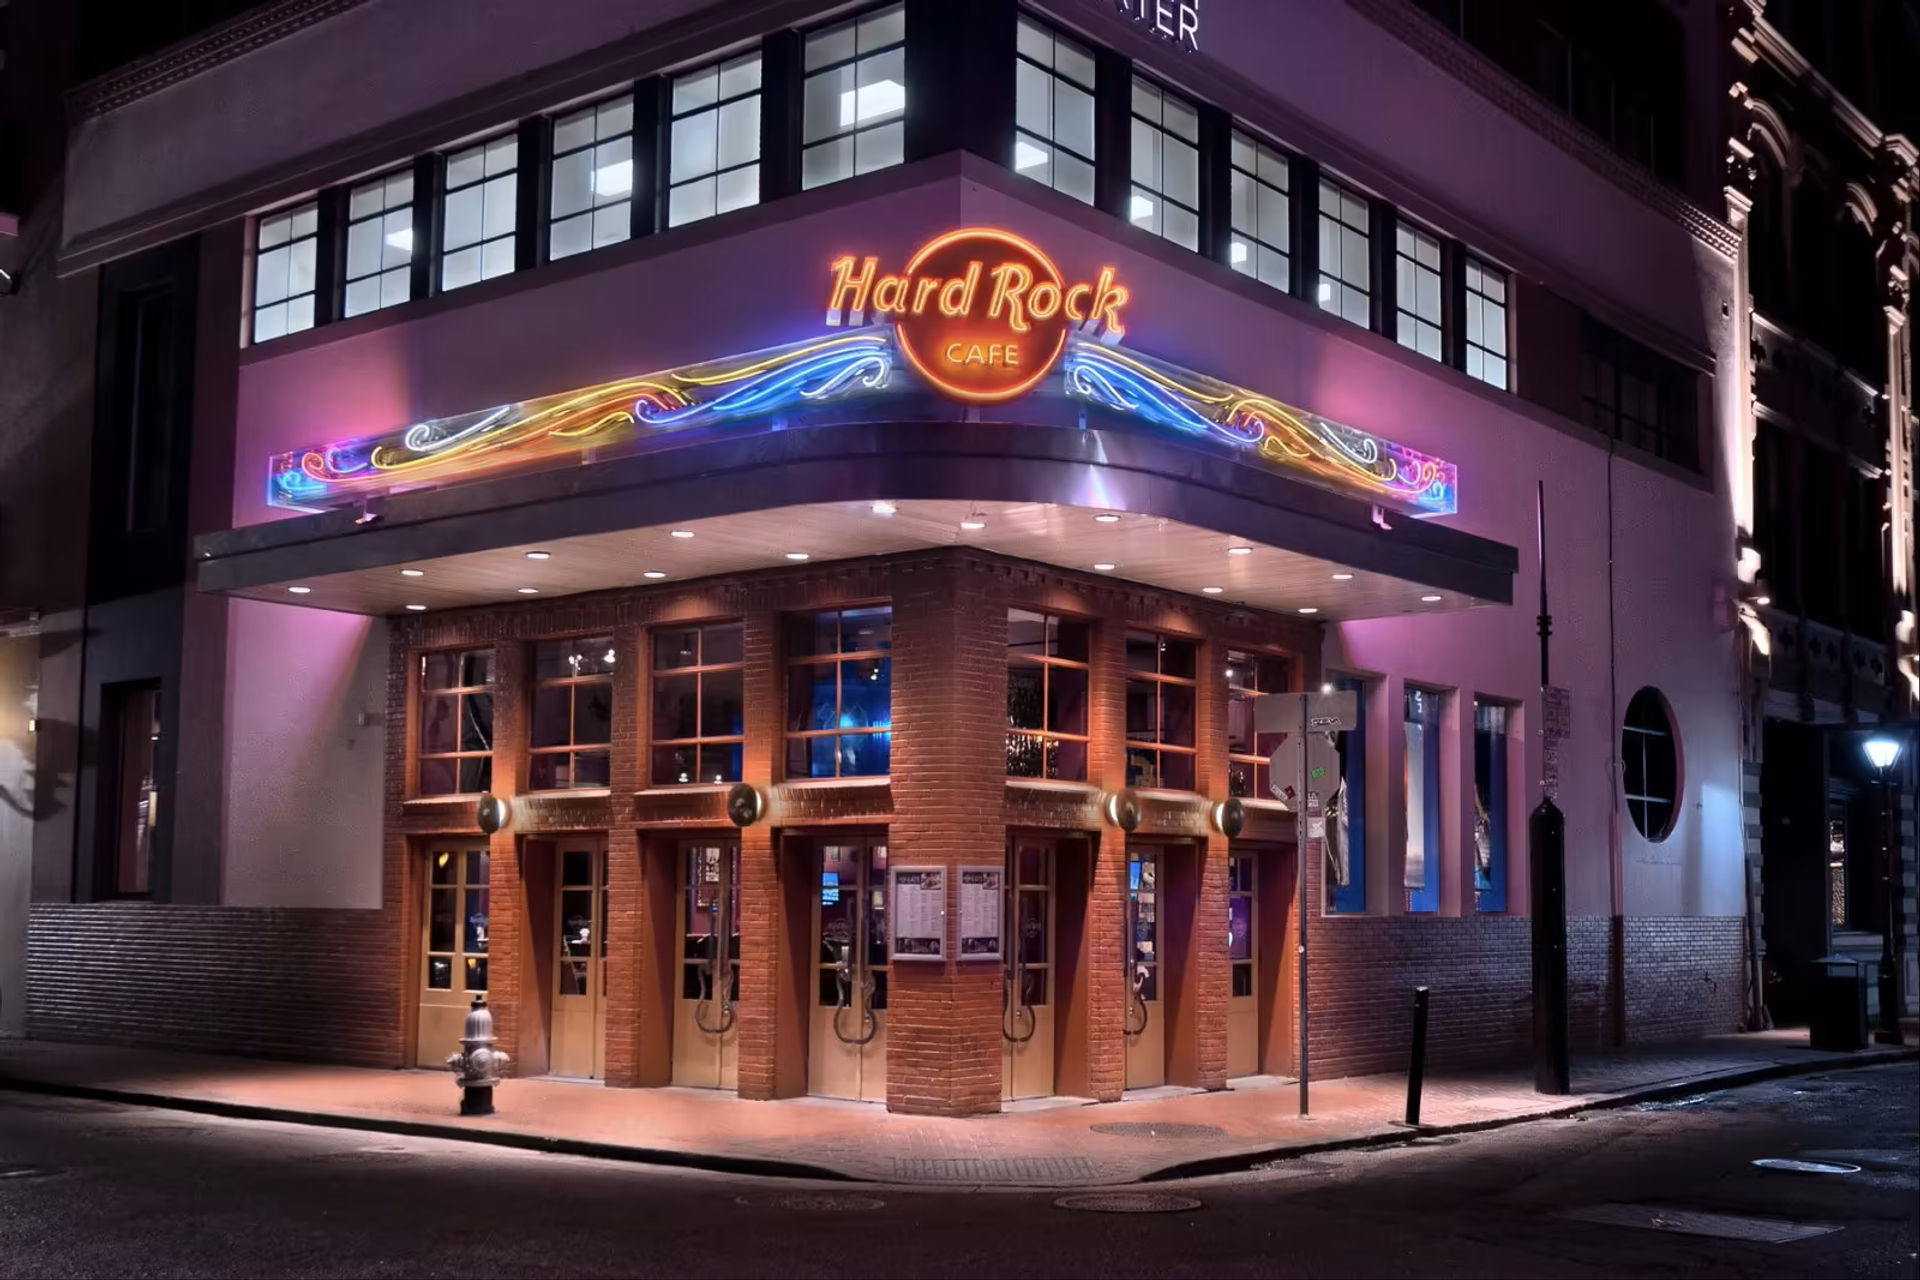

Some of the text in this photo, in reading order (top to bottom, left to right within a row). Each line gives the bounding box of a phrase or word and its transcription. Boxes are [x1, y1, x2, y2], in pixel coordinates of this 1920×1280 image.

[829, 256, 1129, 334] Hard Rock
[945, 343, 1020, 367] CAFE
